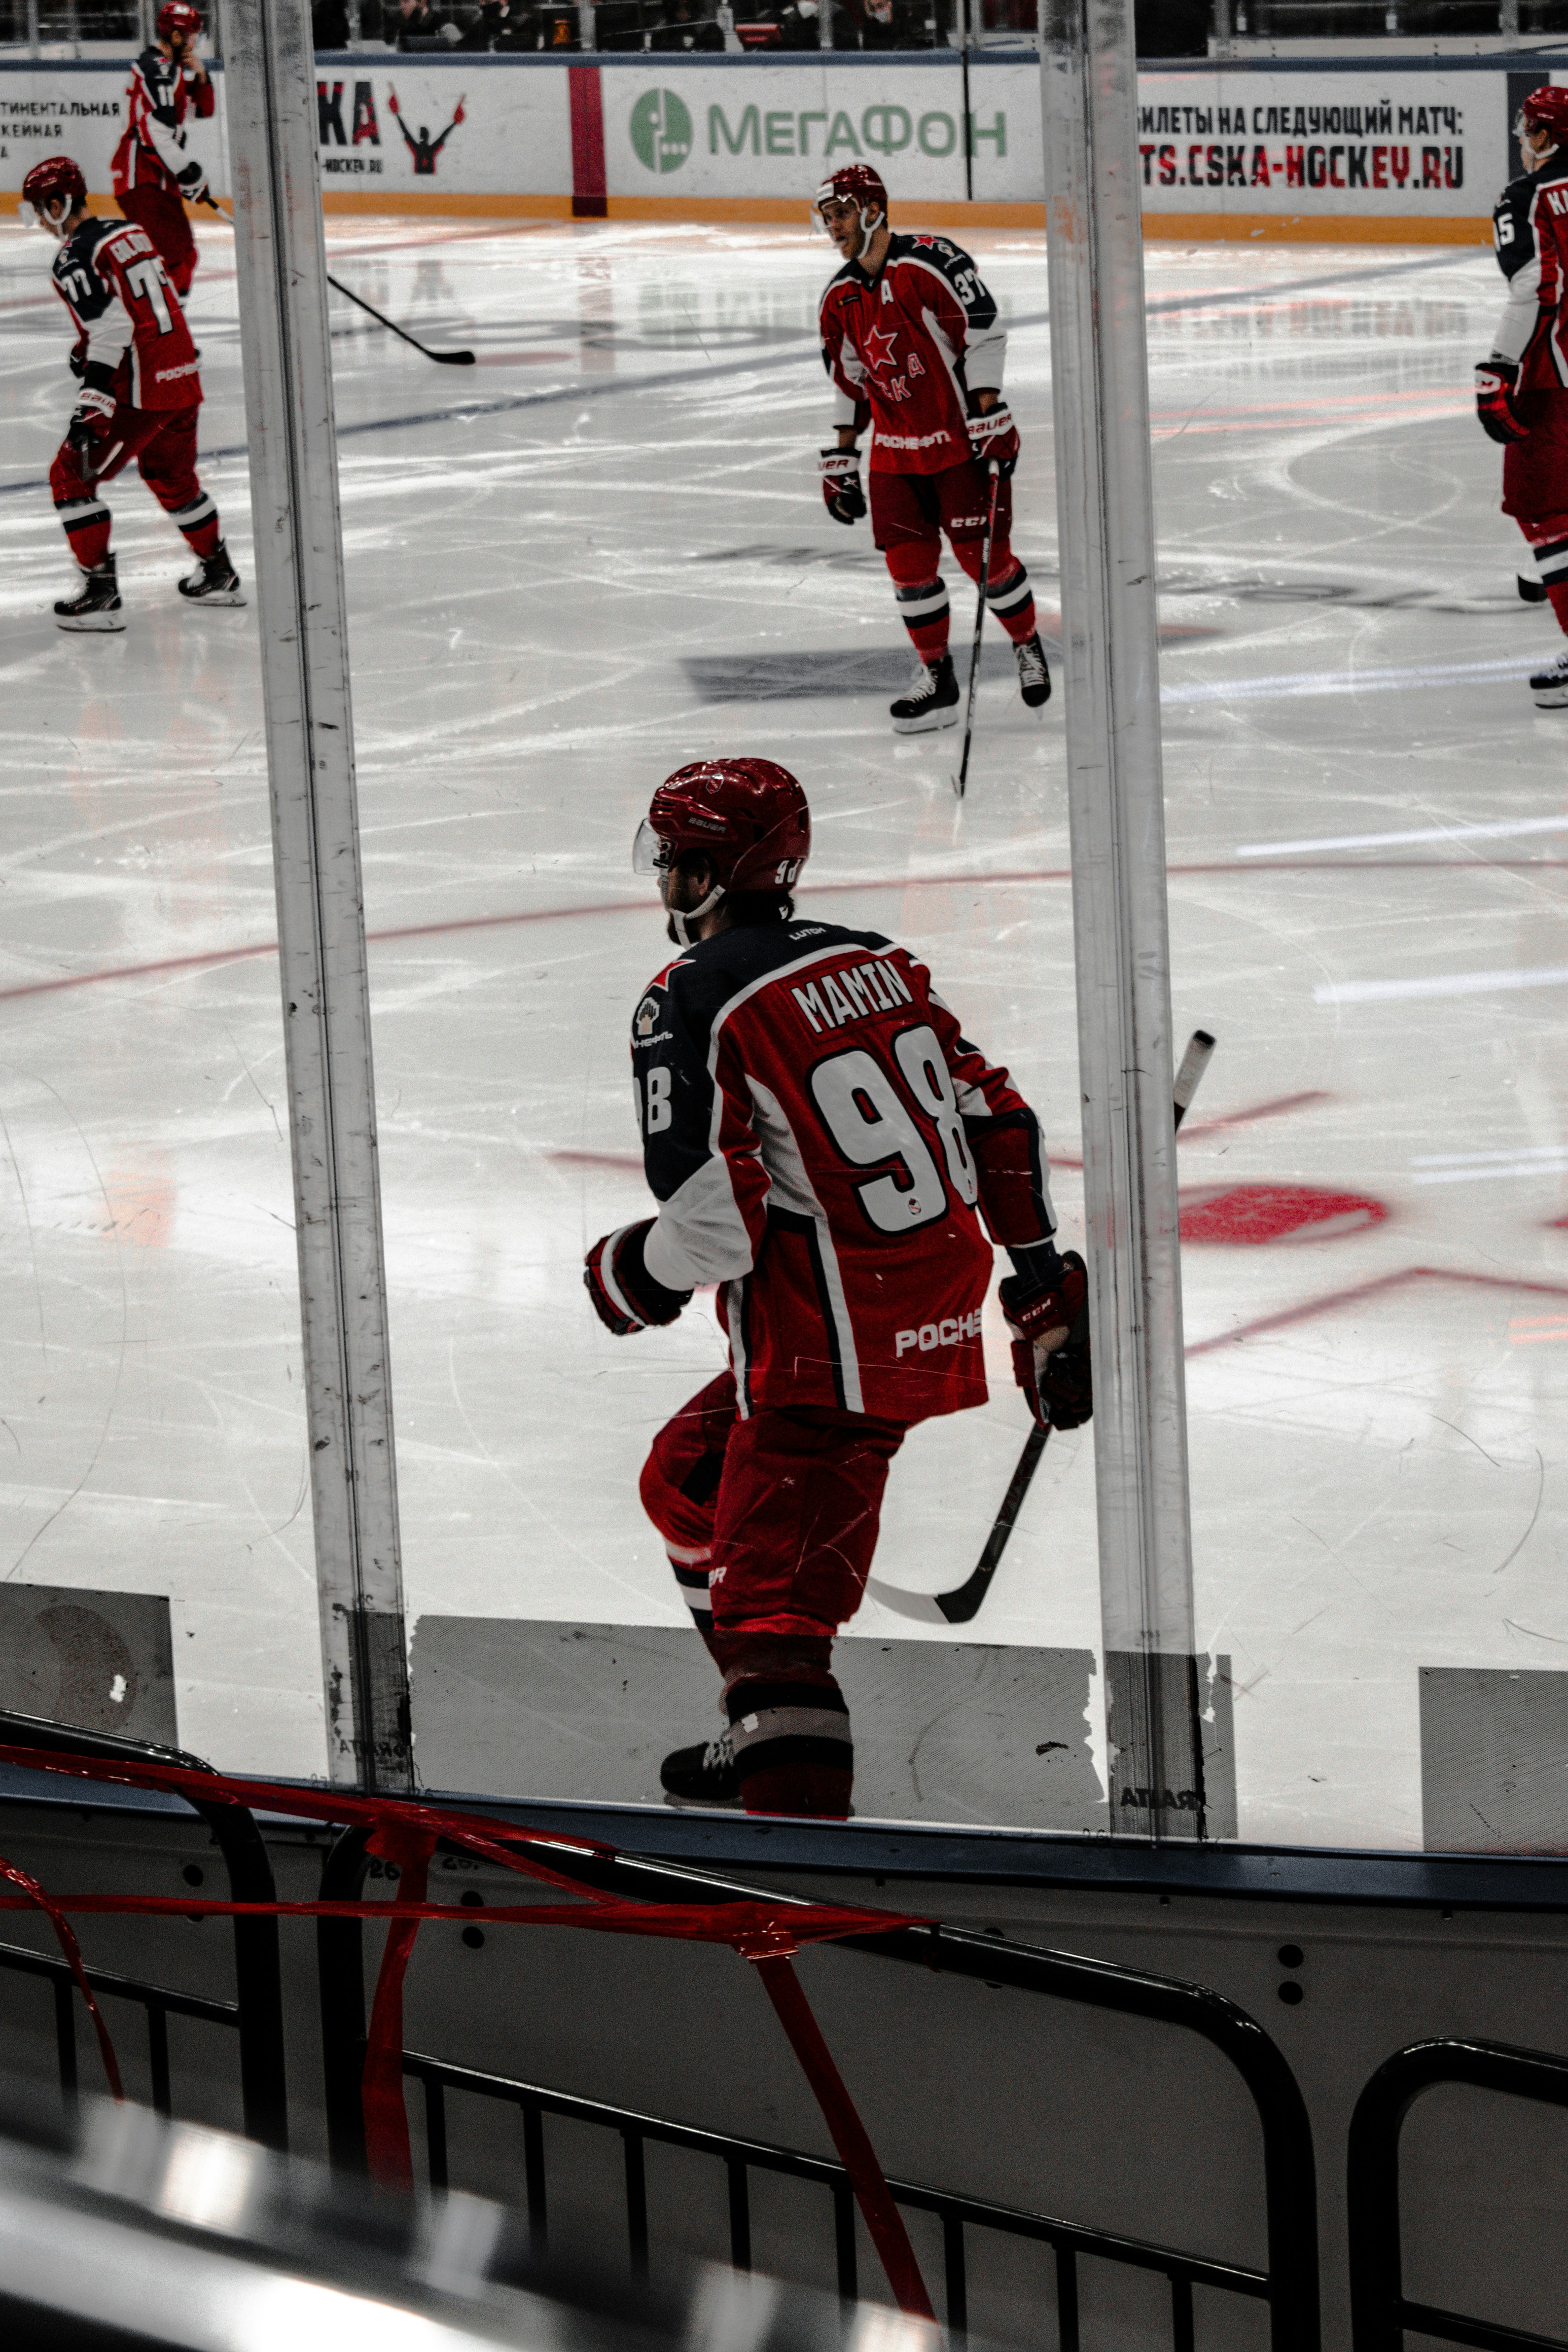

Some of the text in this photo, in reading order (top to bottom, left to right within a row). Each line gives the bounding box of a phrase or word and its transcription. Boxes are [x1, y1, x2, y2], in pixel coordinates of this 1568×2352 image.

[0, 102, 120, 116] ТИНЕНТАЛЬНАЯ
[1218, 107, 1246, 134] НА
[1253, 99, 1392, 137] СЛЕДУЮЩИЙ
[1399, 106, 1463, 135] МАТЧ:
[881, 278, 894, 305] A
[954, 268, 985, 305] 37
[789, 927, 826, 940] LUTCH
[790, 958, 913, 1033] MAMIN
[810, 1024, 978, 1233] 98
